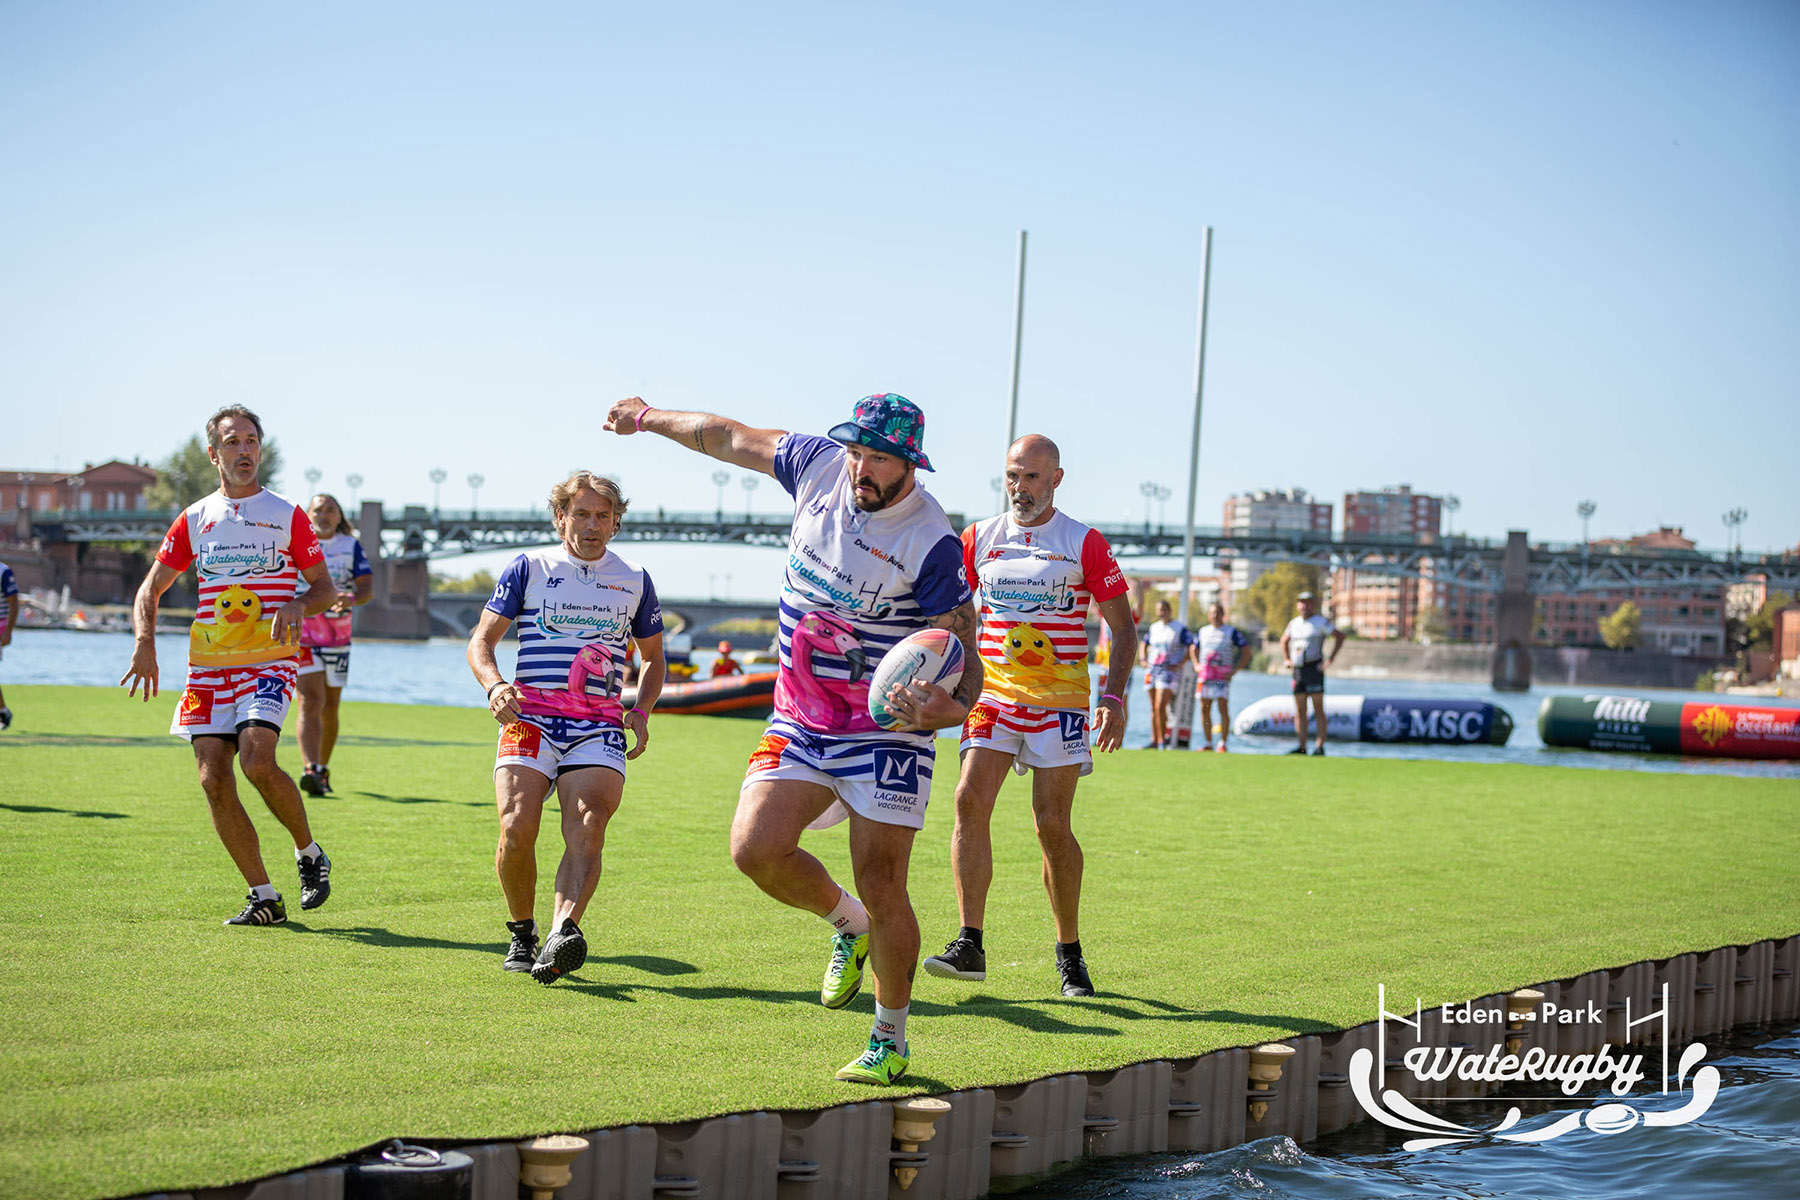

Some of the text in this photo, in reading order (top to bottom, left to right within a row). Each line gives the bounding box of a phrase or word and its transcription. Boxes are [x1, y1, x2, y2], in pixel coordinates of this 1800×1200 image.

[213, 544, 231, 552] Eden
[854, 538, 870, 552] Das
[205, 553, 268, 566] WateRugby
[987, 550, 1005, 561] MF
[802, 545, 854, 585] Eden Park
[546, 577, 565, 588] MF
[790, 554, 865, 609] WateRugby
[997, 577, 1046, 587] Eden Park
[990, 590, 1058, 605] WateRugby
[562, 603, 612, 613] Eden Park
[550, 614, 621, 632] WateRugby
[1409, 708, 1484, 741] MSC
[874, 791, 918, 806] LAGRANGE
[877, 801, 912, 813] vacances
